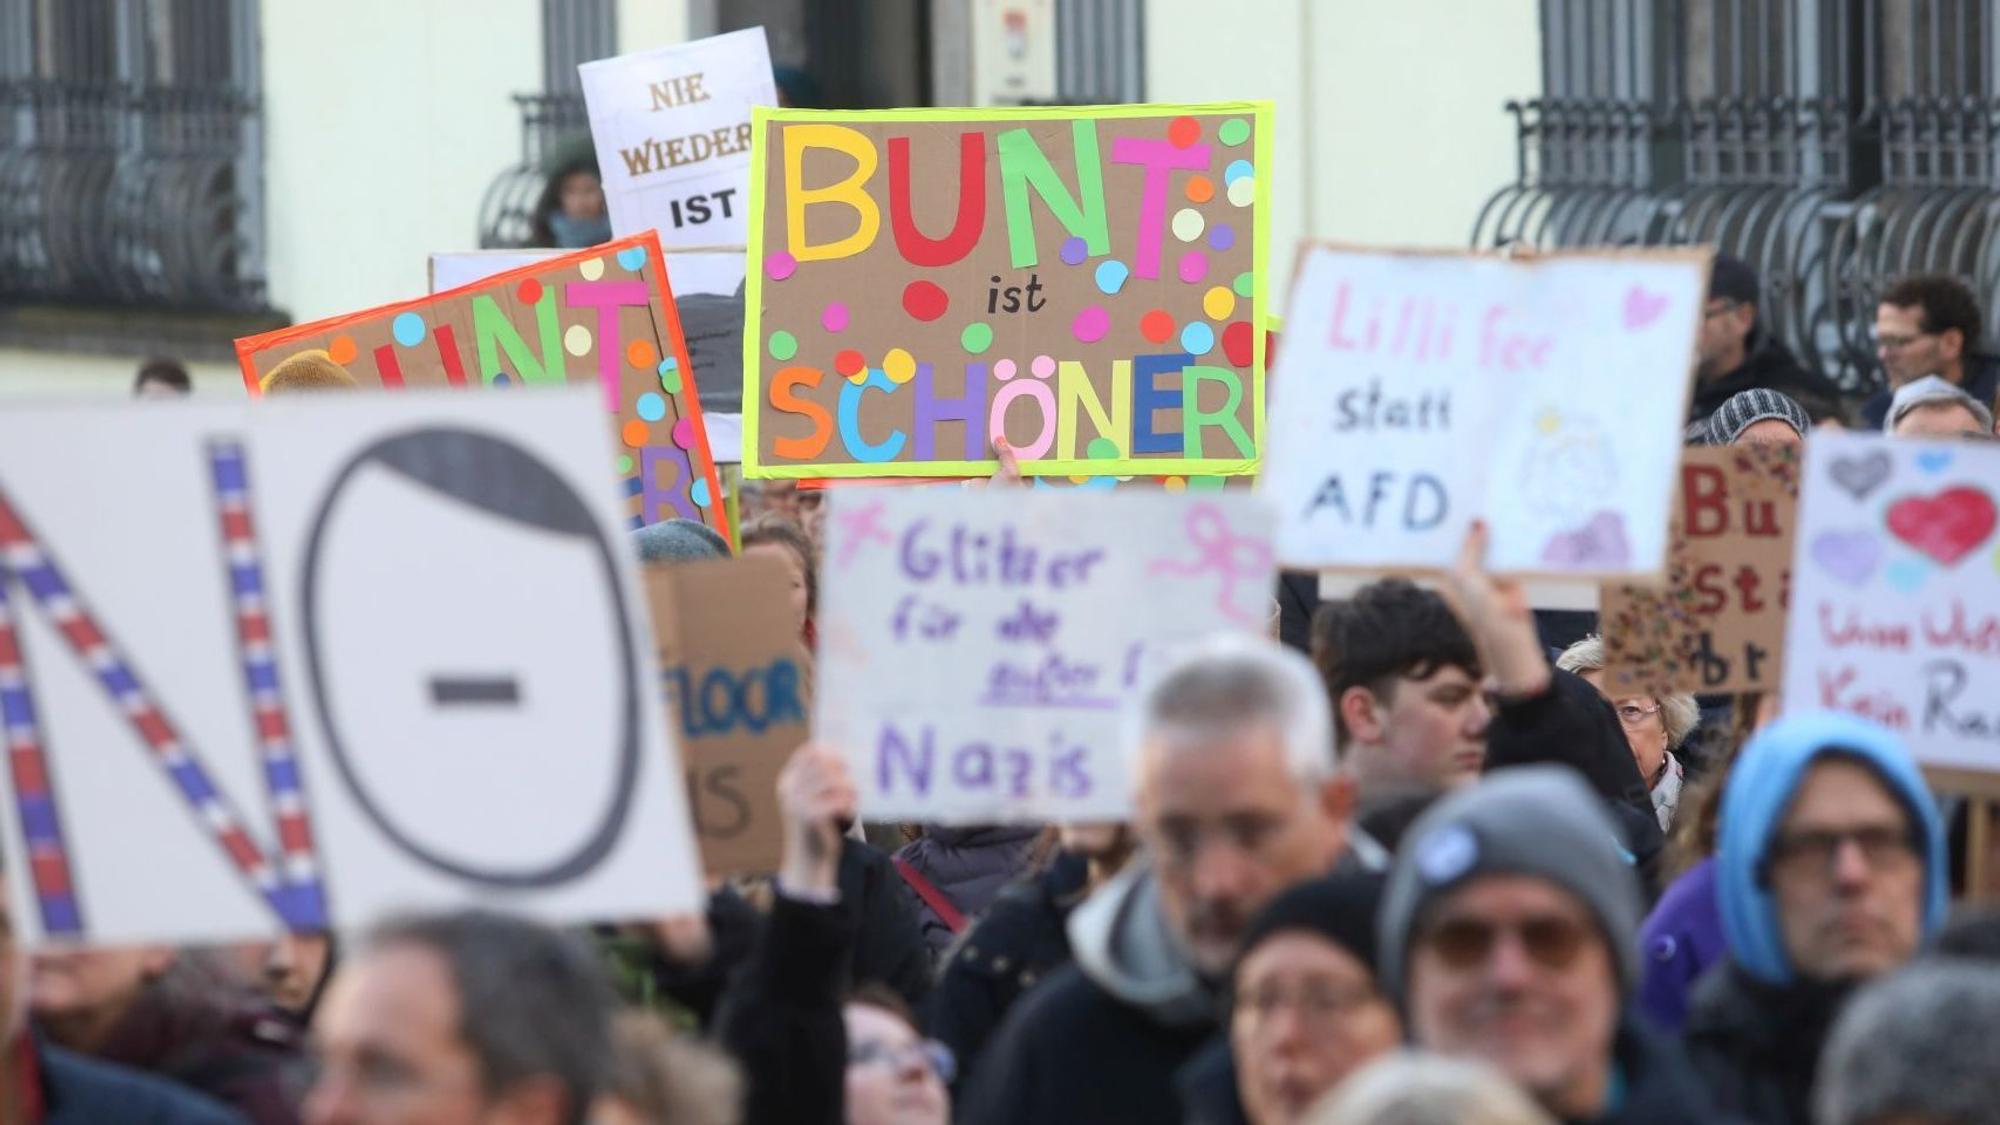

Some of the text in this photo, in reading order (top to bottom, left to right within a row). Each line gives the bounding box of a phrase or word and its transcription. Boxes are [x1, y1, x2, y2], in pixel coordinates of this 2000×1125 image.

[649, 73, 711, 111] NIE
[619, 122, 752, 176] WIEDER
[671, 189, 735, 227] IST
[783, 119, 1211, 281] BUNT
[987, 273, 1047, 314] ist
[768, 353, 1257, 463] SCHÖNER
[1305, 470, 1449, 531] AFD
[0, 424, 642, 940] NO
[874, 721, 1095, 800] Nazis
